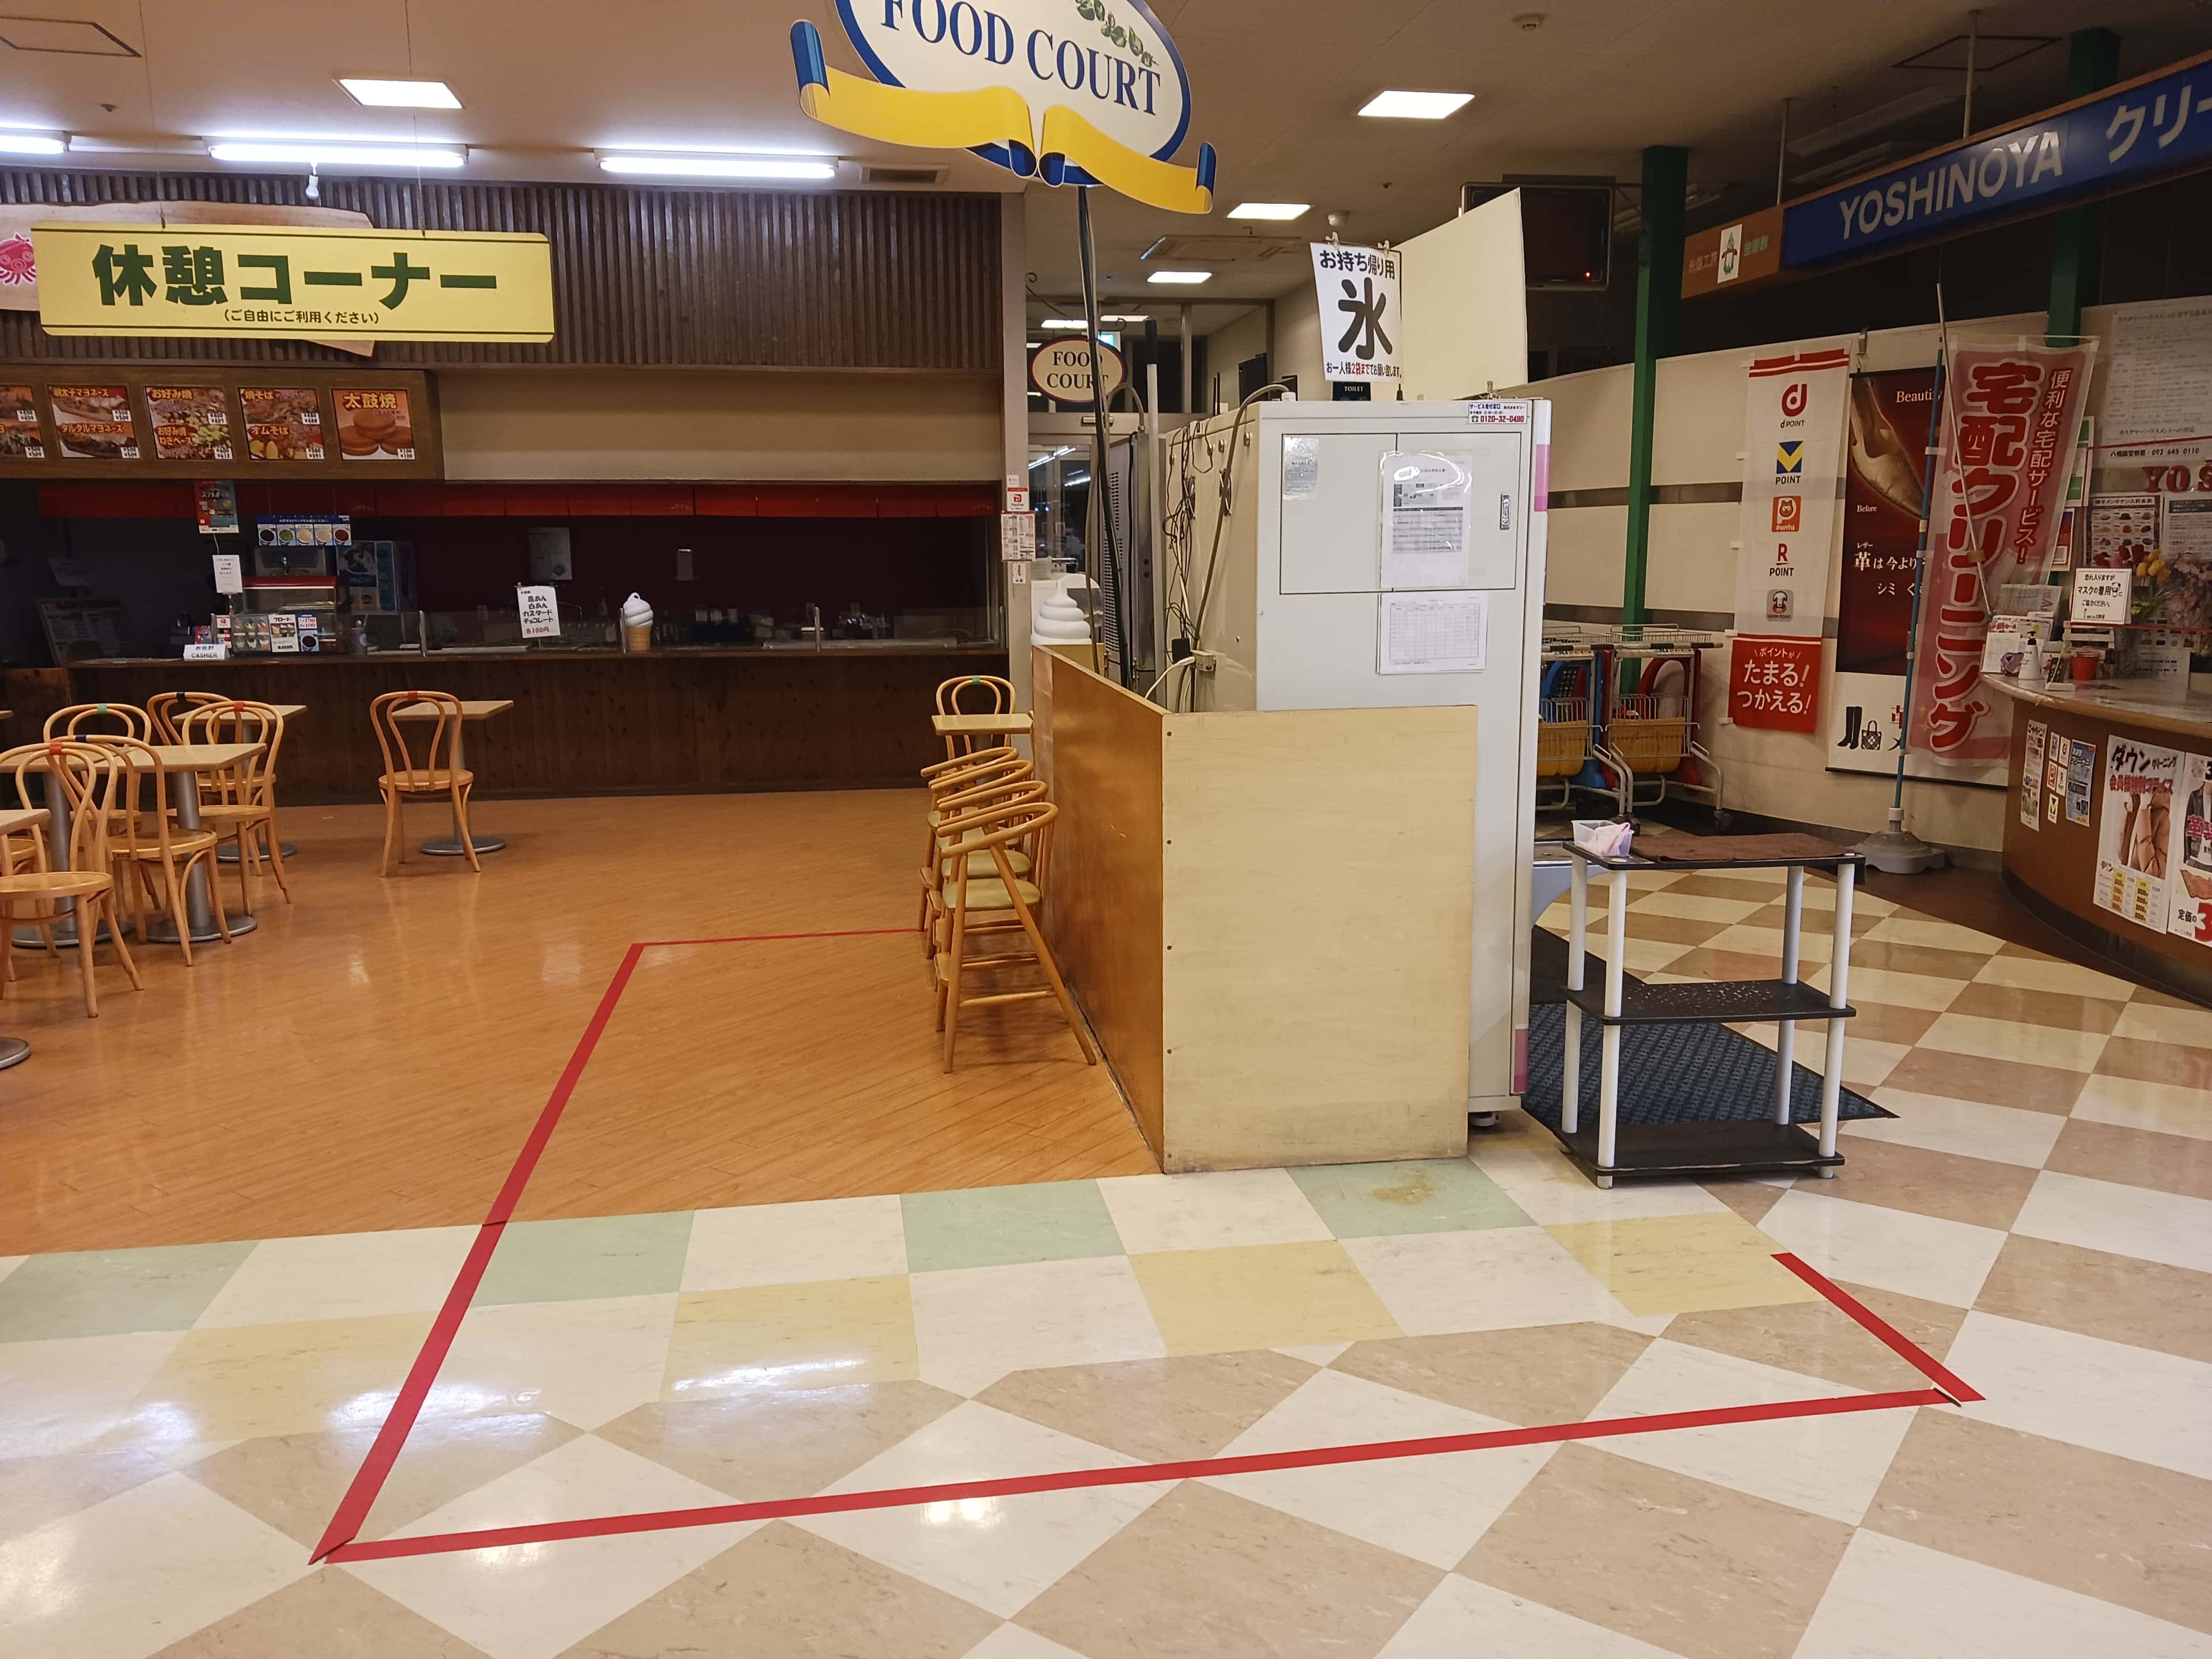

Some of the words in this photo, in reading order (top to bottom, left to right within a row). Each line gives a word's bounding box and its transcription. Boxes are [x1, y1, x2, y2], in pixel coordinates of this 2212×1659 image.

[881, 0, 1014, 65] FOOD
[1027, 29, 1161, 116] COURT
[1839, 130, 2064, 240] YOSHINOYA
[1320, 249, 1395, 280] お持ち帰り用
[92, 243, 497, 310] 休憩コーナー
[1338, 276, 1393, 360] 氷
[344, 392, 397, 408] 太鼓焼
[1896, 388, 1942, 403] Beauti
[251, 426, 289, 435] オムそば
[1775, 476, 1801, 484] POINT
[1857, 505, 1877, 513] Before
[1778, 543, 1789, 562] R
[1930, 362, 2041, 752] 宅配クリーニング
[1854, 551, 1926, 571] 革は今より
[1770, 567, 1794, 576] POINT
[2078, 585, 2112, 596] マスクの着用
[522, 609, 552, 618] カスタード
[523, 616, 554, 624] チョコレート
[2111, 744, 2151, 772] ダウン
[2178, 908, 2197, 923] 定価の
